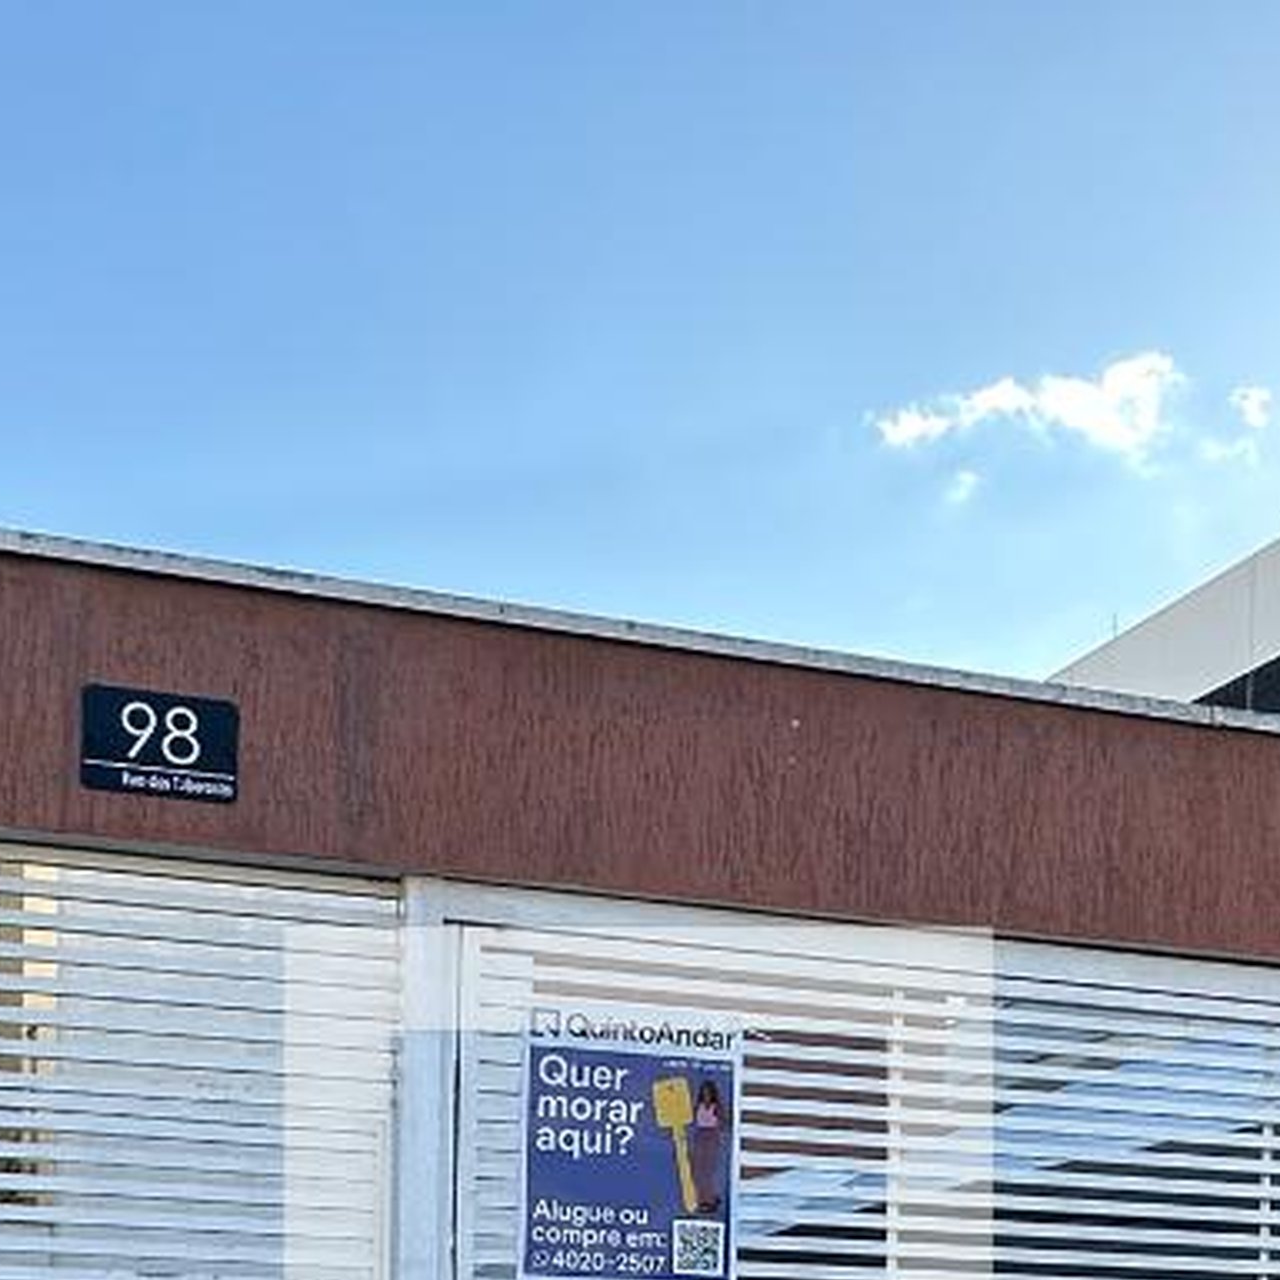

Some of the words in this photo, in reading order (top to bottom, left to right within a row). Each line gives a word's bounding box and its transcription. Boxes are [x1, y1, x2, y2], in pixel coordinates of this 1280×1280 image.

[121, 701, 200, 765] 98
[567, 1012, 735, 1050] QuintoAndar
[538, 1054, 629, 1091] Quer
[537, 1095, 645, 1124] morar
[535, 1123, 635, 1160] aqui?
[532, 1199, 616, 1227] Alugue
[620, 1208, 648, 1225] ou
[532, 1226, 621, 1248] compre
[552, 1249, 666, 1274] 4020-2507
